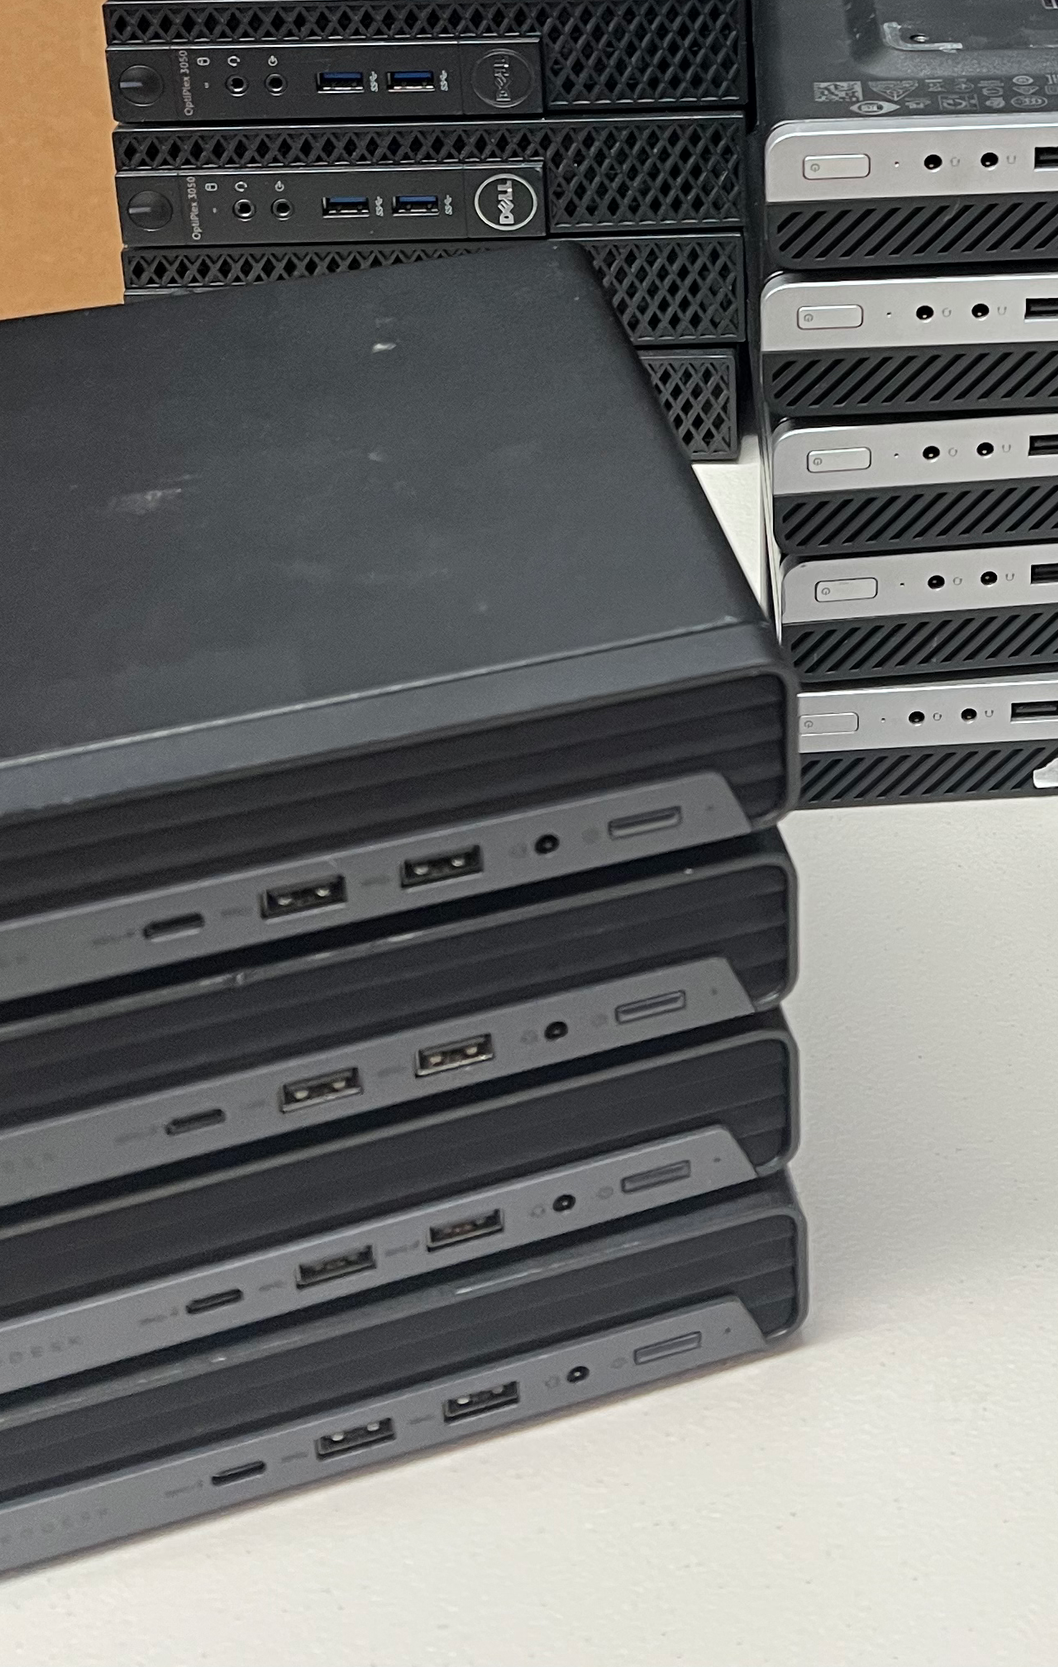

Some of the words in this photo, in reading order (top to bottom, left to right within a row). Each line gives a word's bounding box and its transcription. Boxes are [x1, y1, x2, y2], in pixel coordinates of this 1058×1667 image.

[178, 50, 189, 74] 3050
[181, 76, 194, 116] OptiPlex
[186, 176, 197, 199] 3050
[190, 201, 203, 241] OptiPlex
